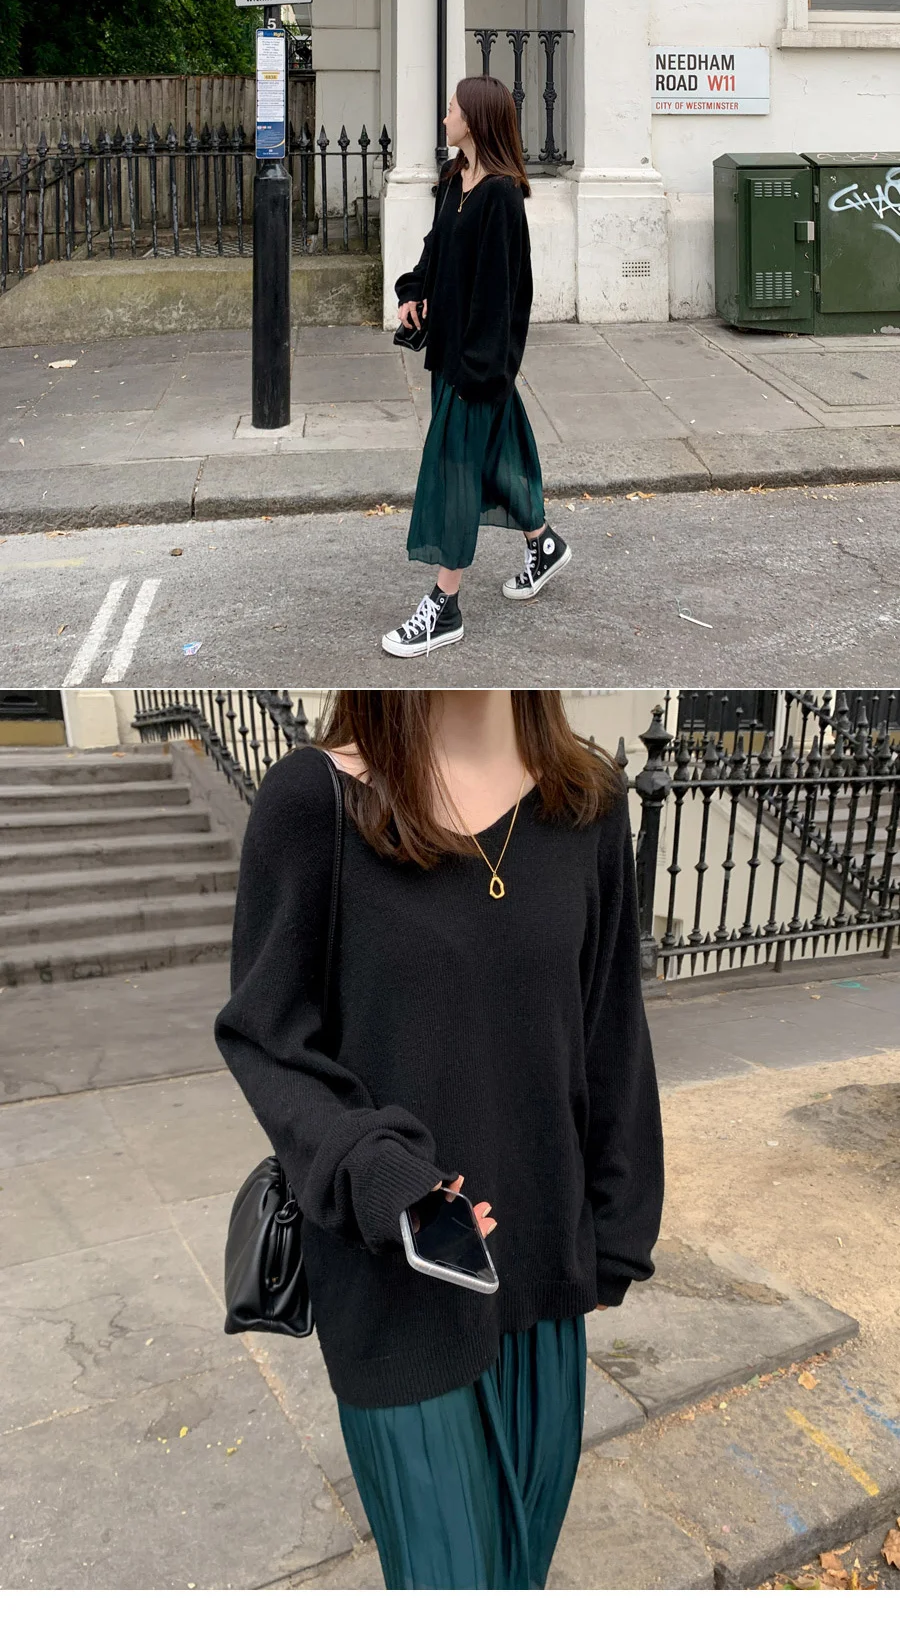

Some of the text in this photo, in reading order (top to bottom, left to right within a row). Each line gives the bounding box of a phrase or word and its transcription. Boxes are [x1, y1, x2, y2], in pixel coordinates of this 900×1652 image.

[267, 18, 276, 29] 5
[656, 54, 735, 70] NEEDHAM
[656, 75, 735, 91] ROAD W11
[656, 102, 738, 110] CITY OF WESTMINSTER
